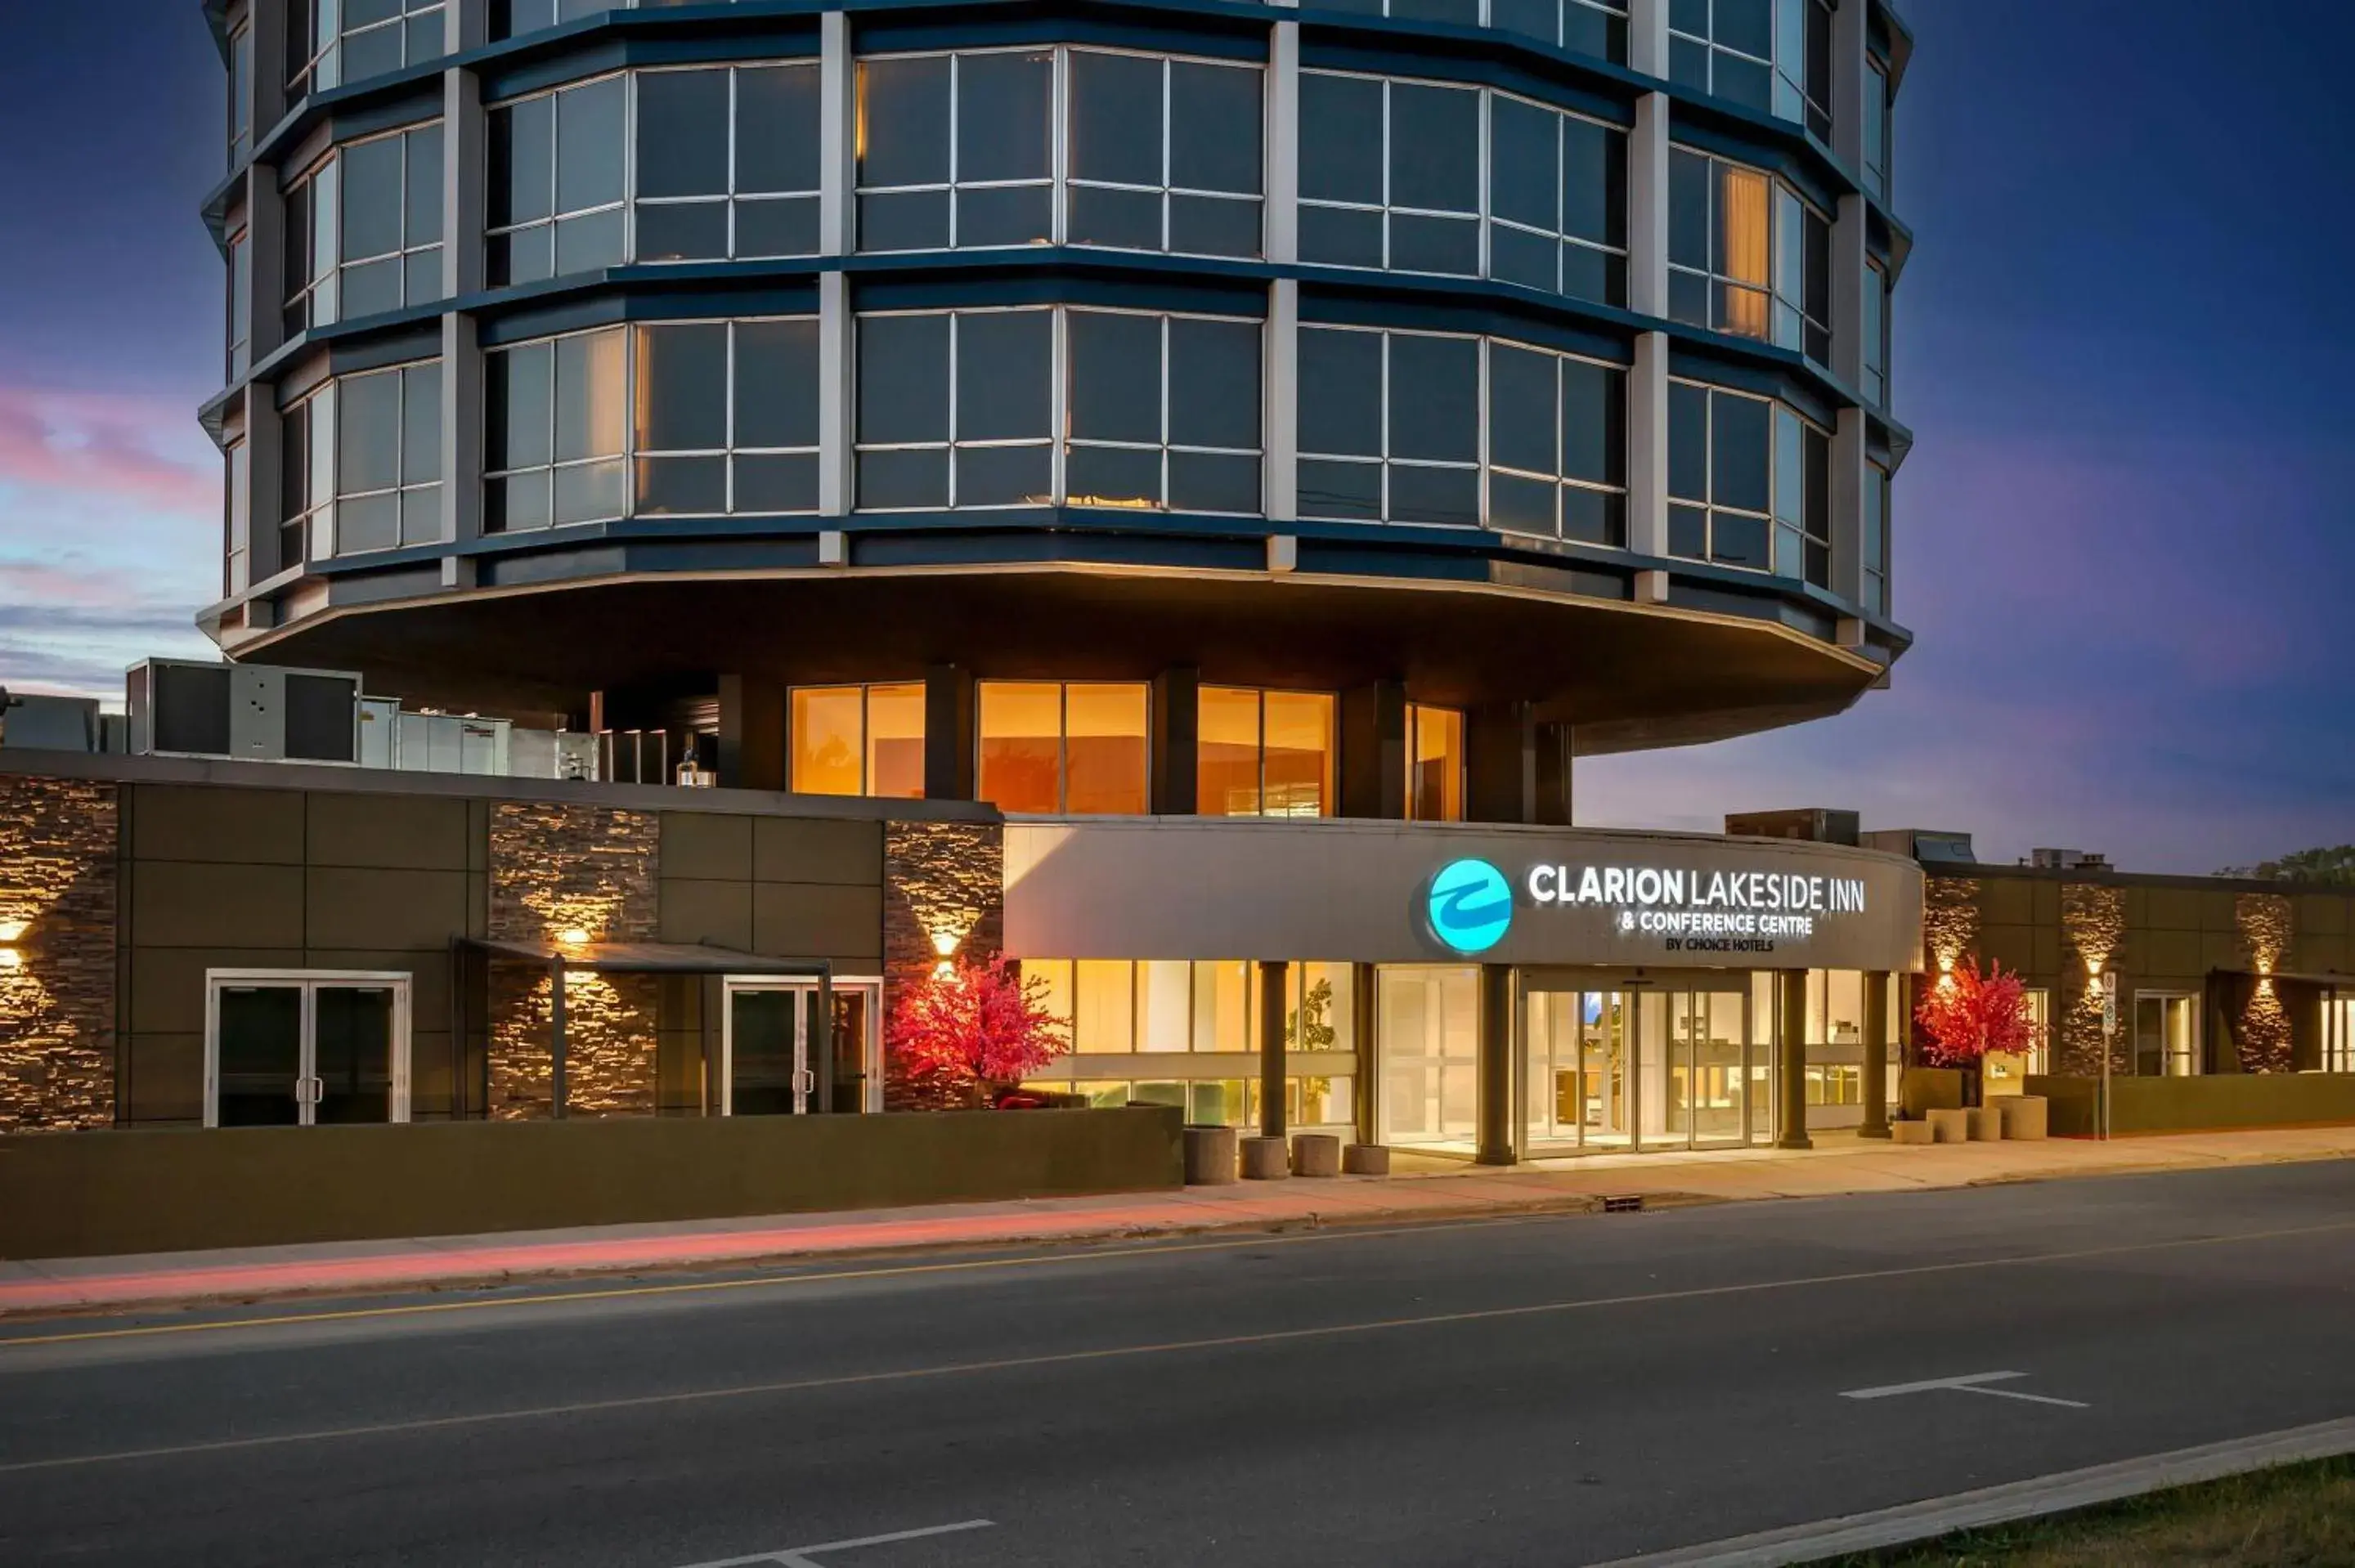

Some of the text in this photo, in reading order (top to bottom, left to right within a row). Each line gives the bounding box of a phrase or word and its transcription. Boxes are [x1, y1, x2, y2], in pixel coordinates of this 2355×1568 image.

[1528, 864, 1865, 913] CLARION LAKESIDE INN
[1621, 911, 1813, 935] & CONFERENCE CENTRE
[1666, 938, 1774, 952] BY CHOICE HOTELS
